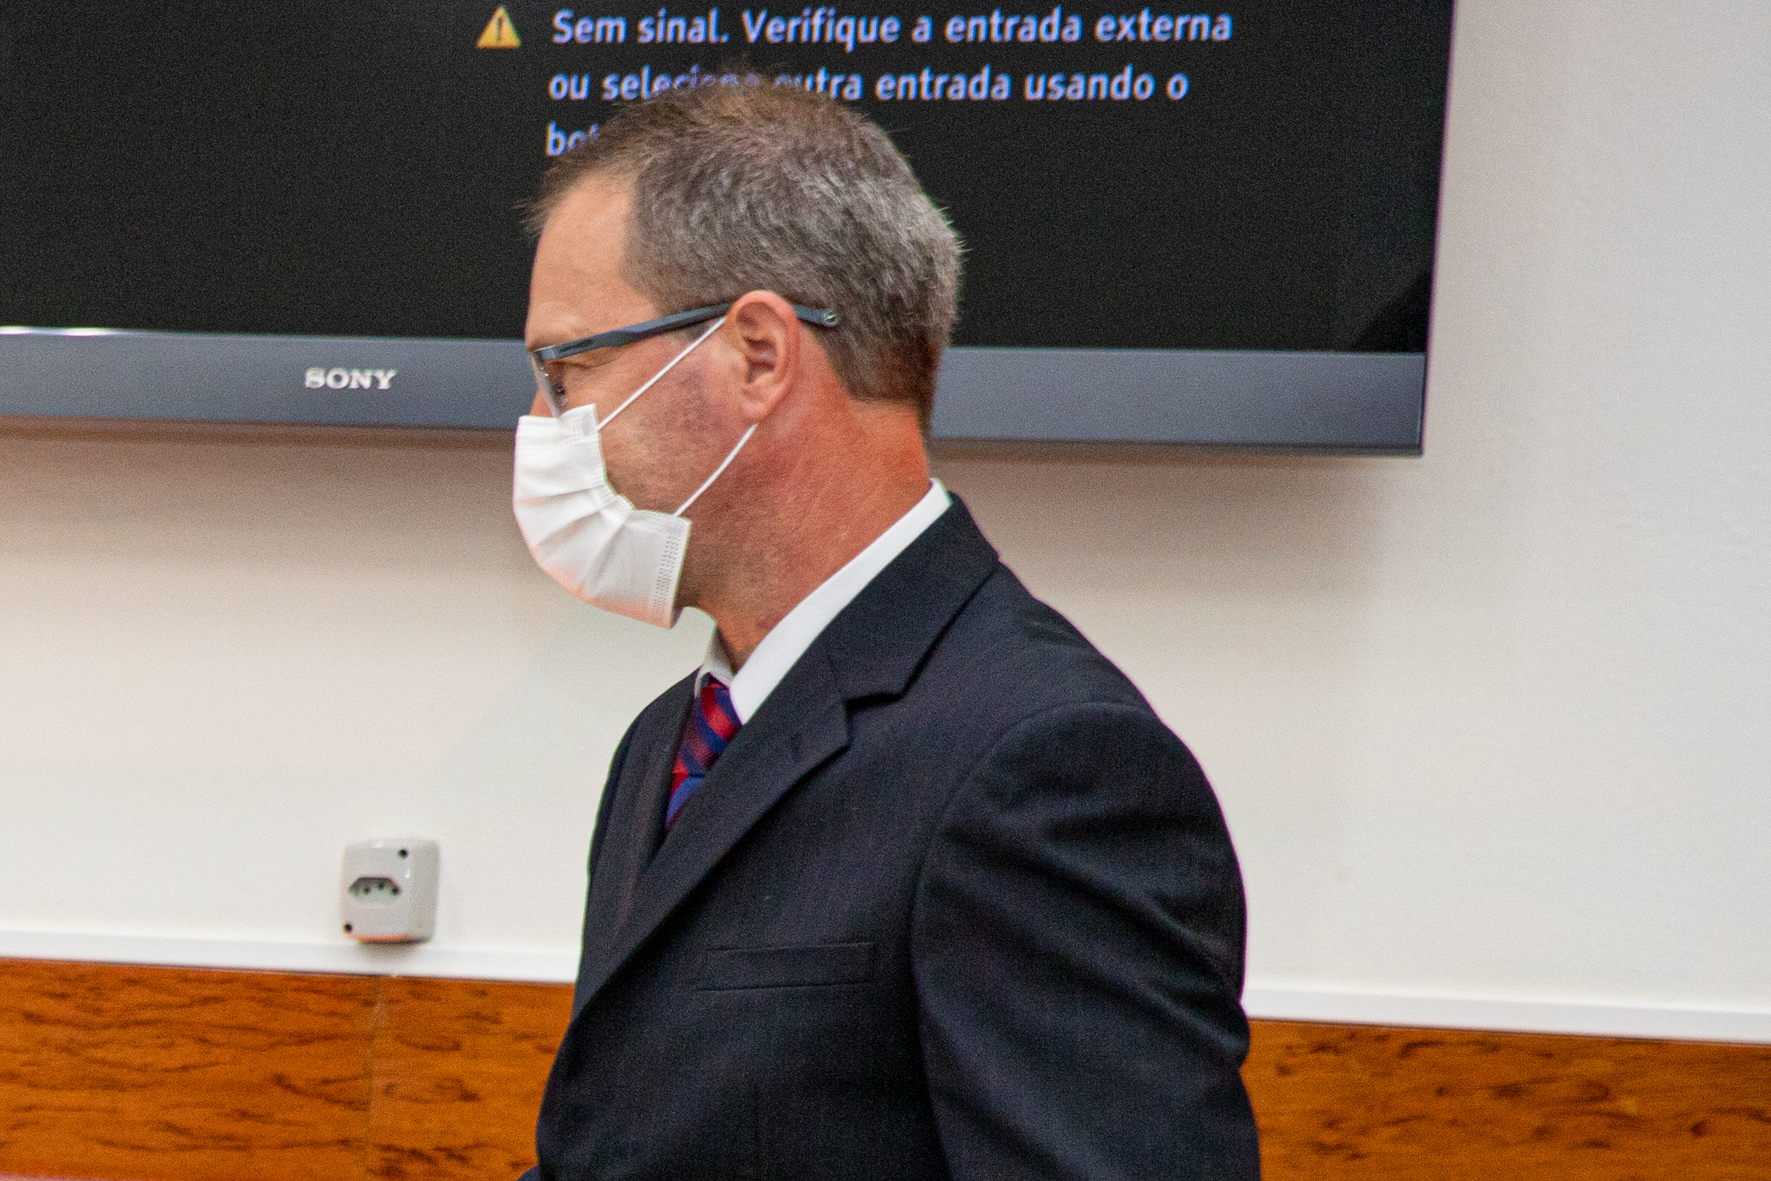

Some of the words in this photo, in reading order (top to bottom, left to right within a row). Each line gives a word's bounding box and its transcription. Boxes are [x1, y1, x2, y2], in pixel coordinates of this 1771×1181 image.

[552, 9, 627, 43] Sem
[637, 7, 730, 43] sinal.
[741, 6, 901, 53] Verifique
[911, 14, 933, 43] a
[944, 5, 1083, 43] entrada
[1094, 6, 1233, 43] externa
[548, 72, 590, 100] ou
[874, 63, 1011, 101] entrada
[1023, 63, 1156, 101] usando
[1165, 72, 1190, 101] o
[305, 367, 398, 390] SONY
